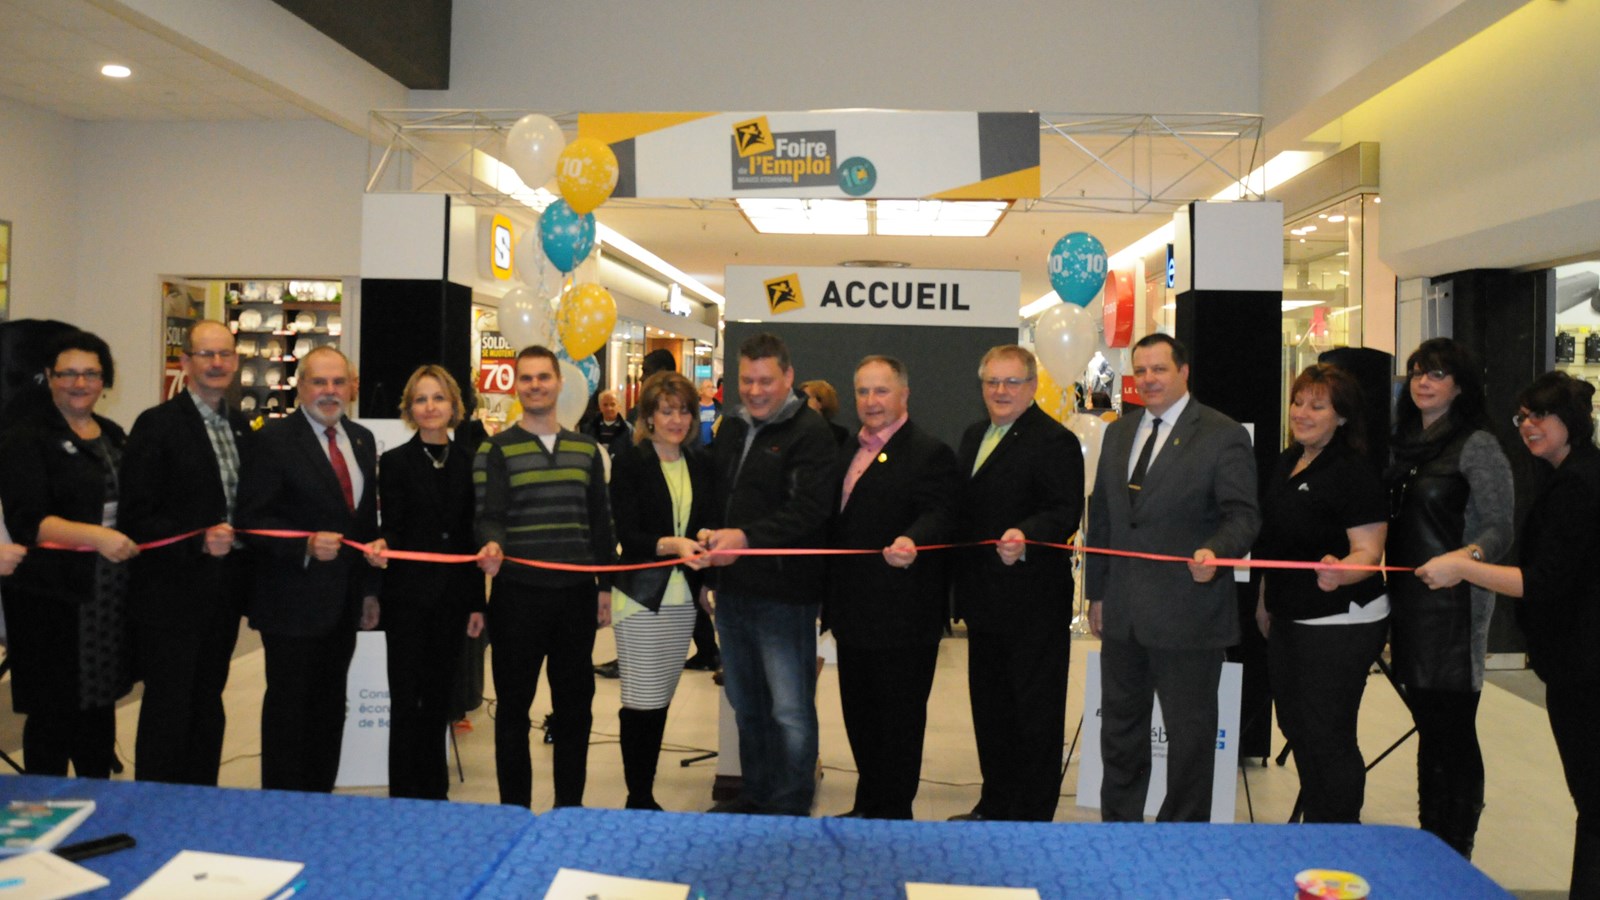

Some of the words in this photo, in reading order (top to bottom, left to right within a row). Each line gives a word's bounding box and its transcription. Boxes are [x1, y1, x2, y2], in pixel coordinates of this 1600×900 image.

[776, 138, 827, 158] Foire
[561, 156, 583, 178] 10
[749, 155, 831, 183] l'Emploi
[1086, 253, 1103, 273] 10
[820, 280, 970, 311] ACCUEIL
